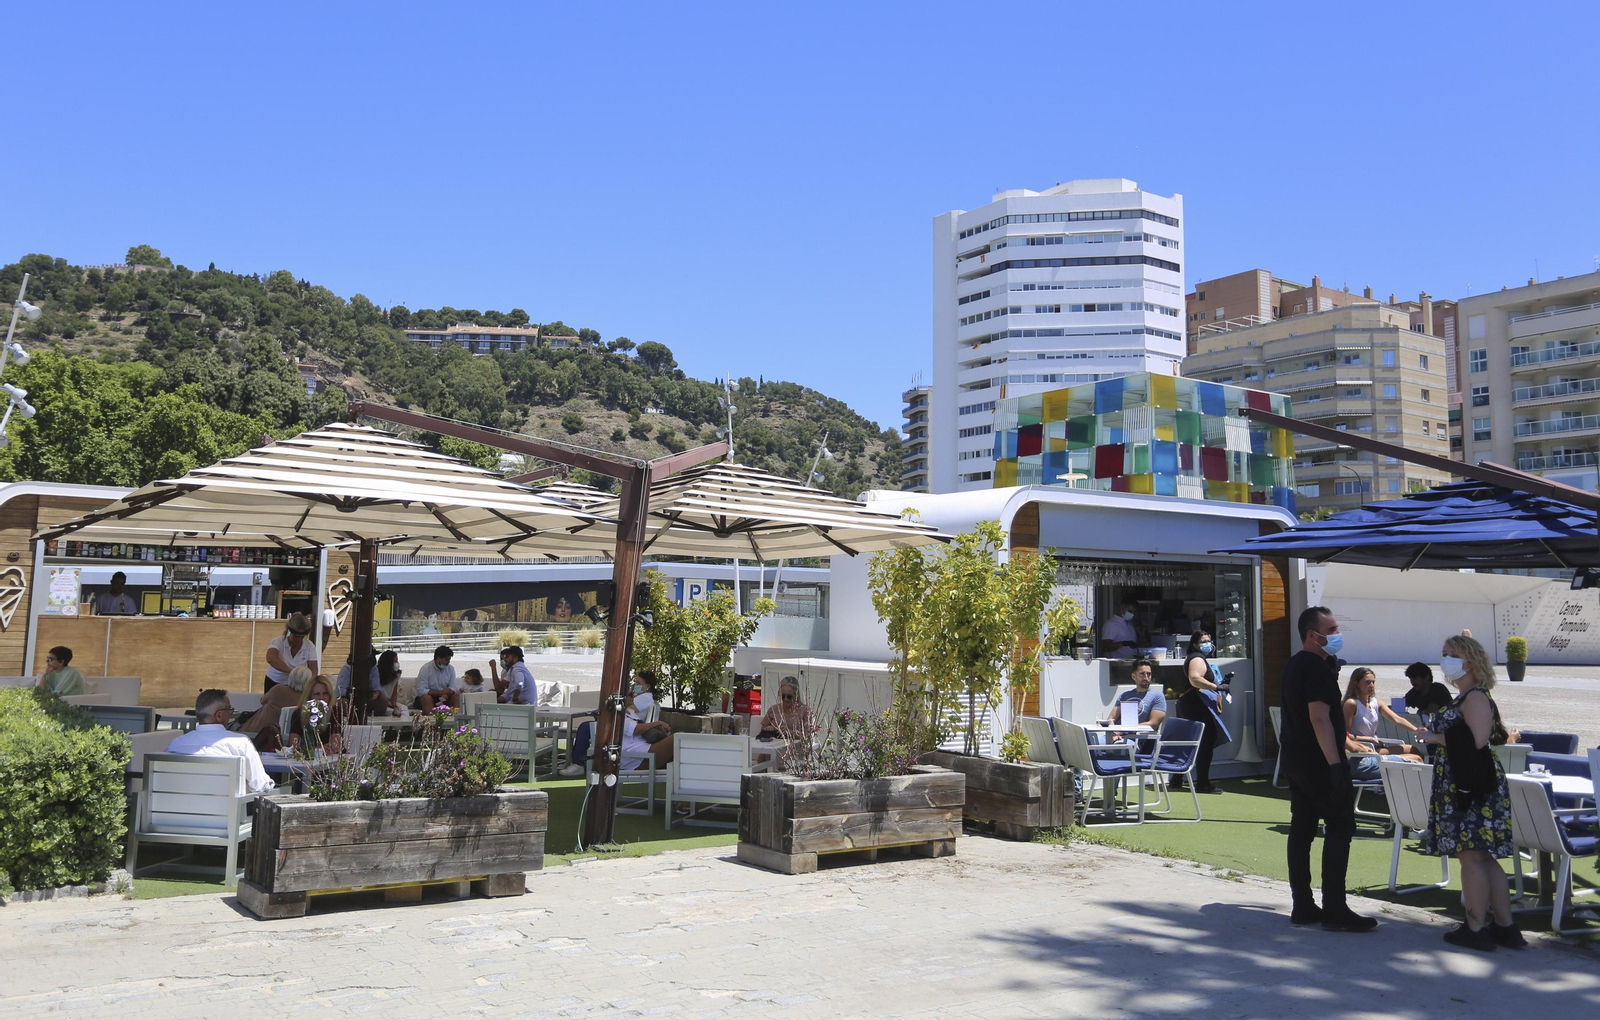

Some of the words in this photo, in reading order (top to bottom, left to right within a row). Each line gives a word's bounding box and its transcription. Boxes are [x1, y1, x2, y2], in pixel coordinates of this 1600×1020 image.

[690, 584, 701, 599] P
[1559, 600, 1583, 615] Centre
[1556, 617, 1590, 635] Pompidou
